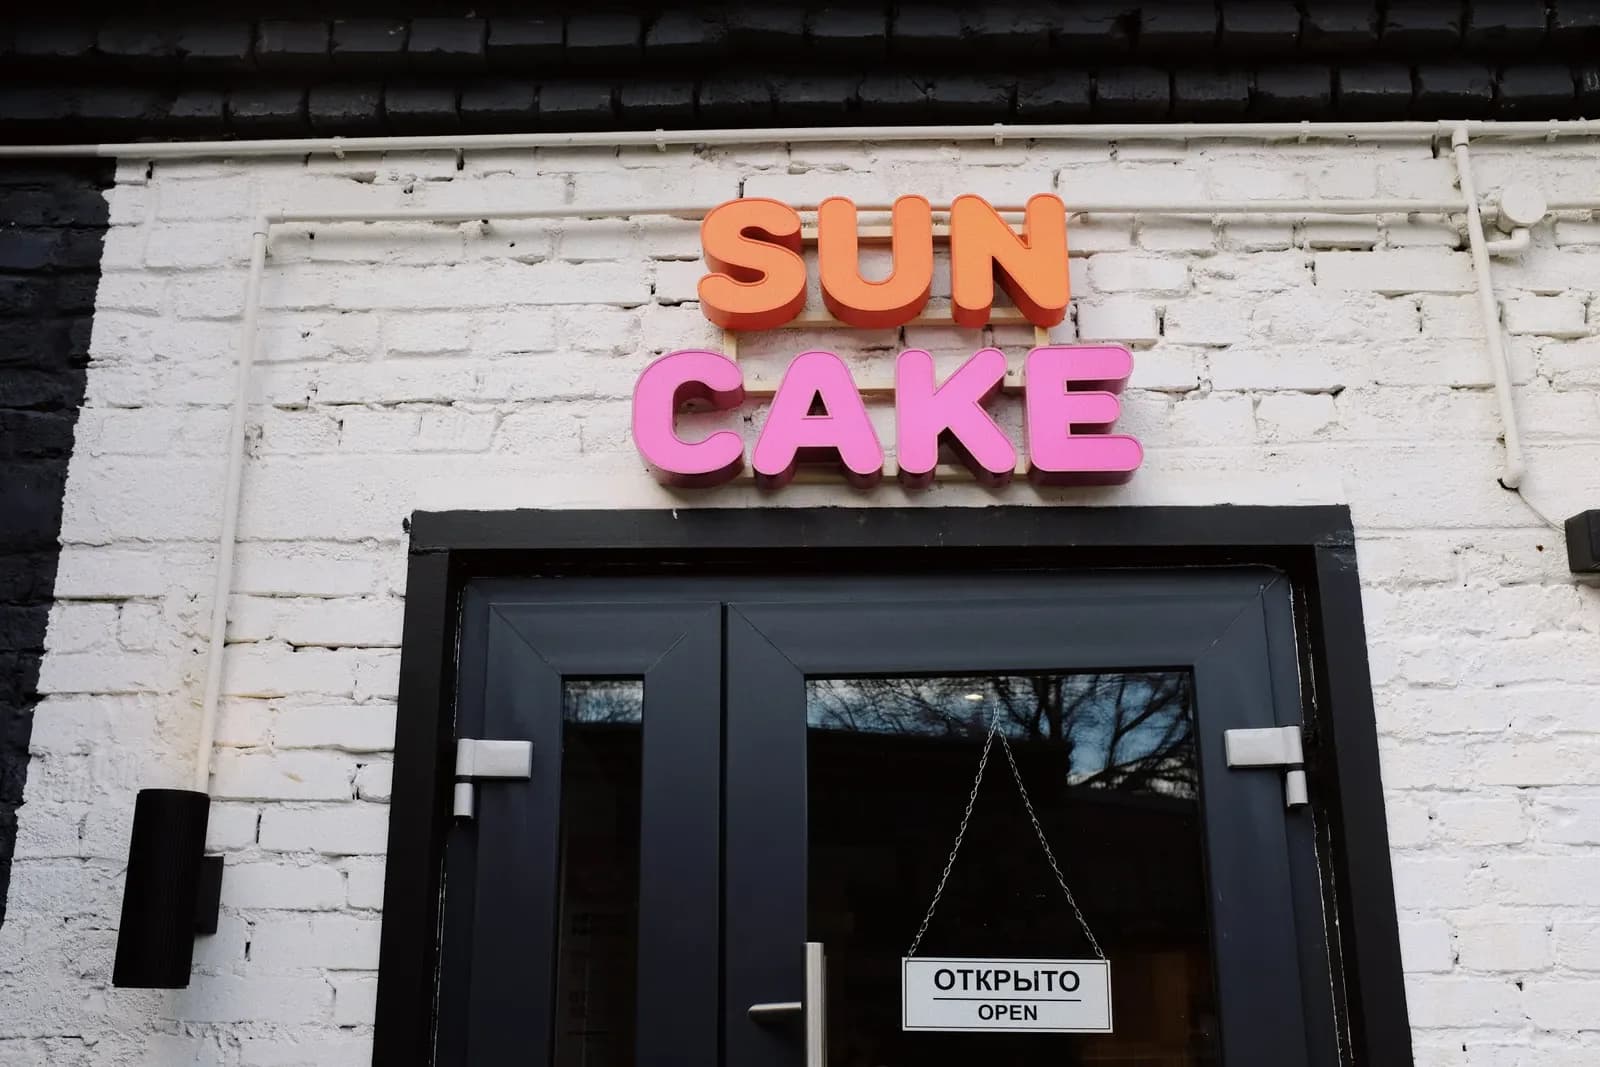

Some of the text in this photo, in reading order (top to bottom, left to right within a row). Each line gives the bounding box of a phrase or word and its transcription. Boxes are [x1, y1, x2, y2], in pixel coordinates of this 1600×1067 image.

[697, 194, 1070, 326] SUN
[632, 344, 1144, 486] CAKE
[933, 968, 1081, 992] ОТКРЫТО
[978, 1003, 1038, 1021] OPEN
